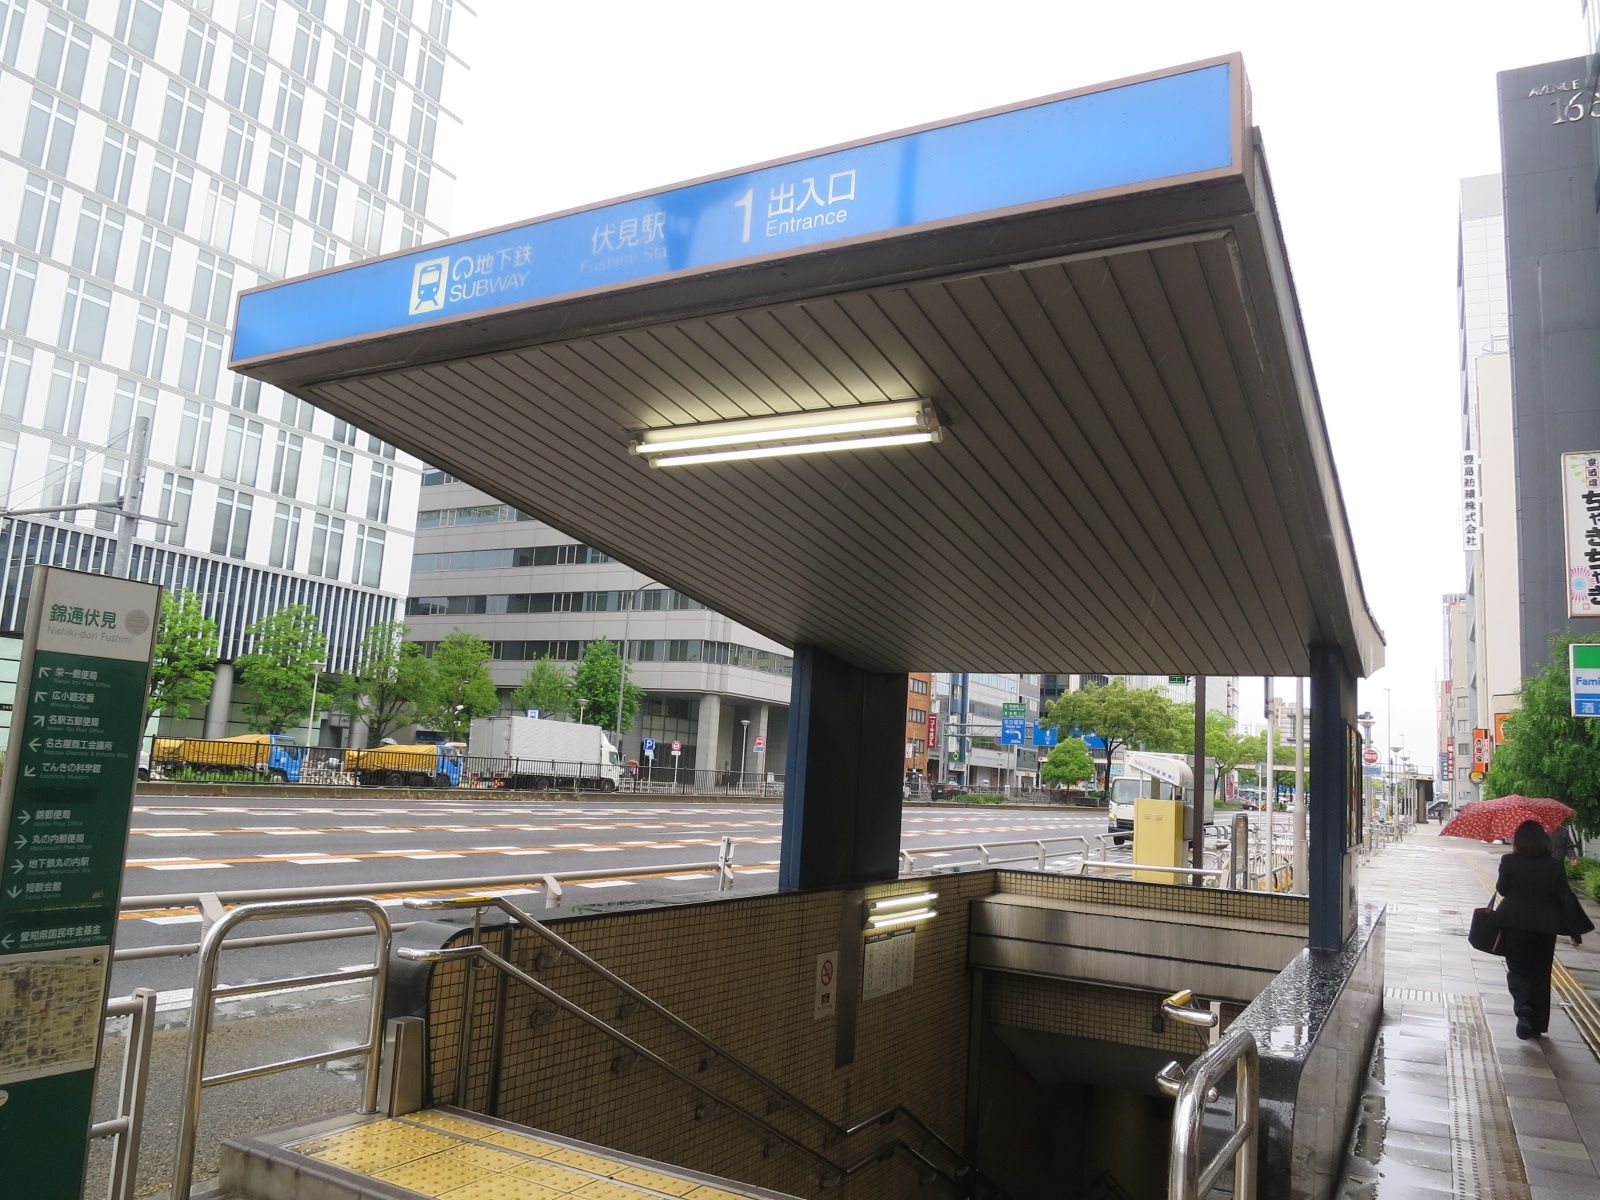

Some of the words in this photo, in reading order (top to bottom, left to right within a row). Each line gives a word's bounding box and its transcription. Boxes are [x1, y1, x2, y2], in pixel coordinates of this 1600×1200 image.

[767, 168, 857, 219] 出入口
[734, 188, 753, 244] 1
[766, 208, 848, 239] Entrance
[591, 211, 667, 255] 伏見駅
[474, 242, 532, 276] 地下鉄
[448, 272, 527, 303] SUBWAY
[49, 603, 117, 630] 錦通伏見
[646, 740, 653, 749] P
